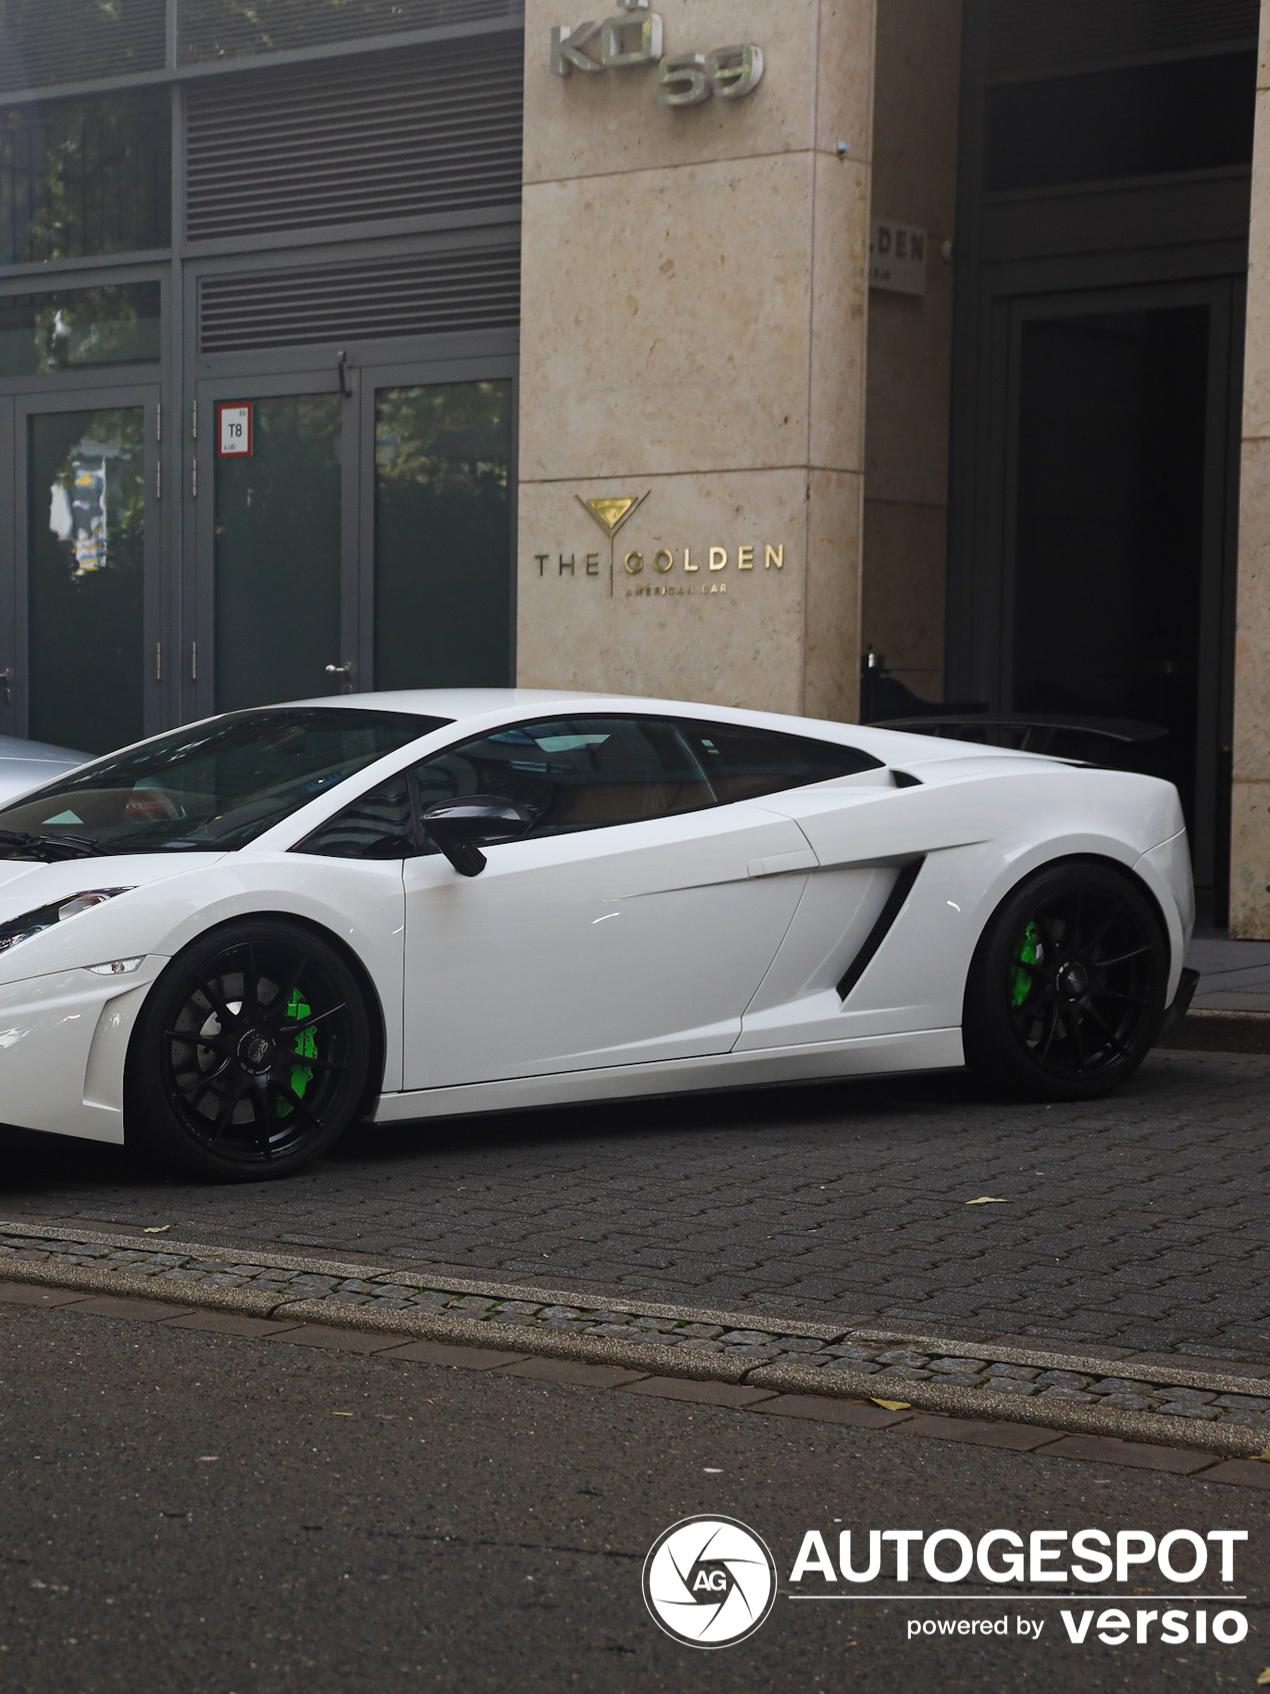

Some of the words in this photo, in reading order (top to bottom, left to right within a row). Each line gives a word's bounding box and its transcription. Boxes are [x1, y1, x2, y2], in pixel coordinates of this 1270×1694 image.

[659, 43, 764, 105] 59
[870, 226, 925, 261] DEN
[228, 423, 242, 437] T8
[534, 553, 599, 576] THE
[624, 544, 785, 574] GOLDEN
[625, 585, 695, 597] AMERICAN
[701, 583, 727, 595] BAR
